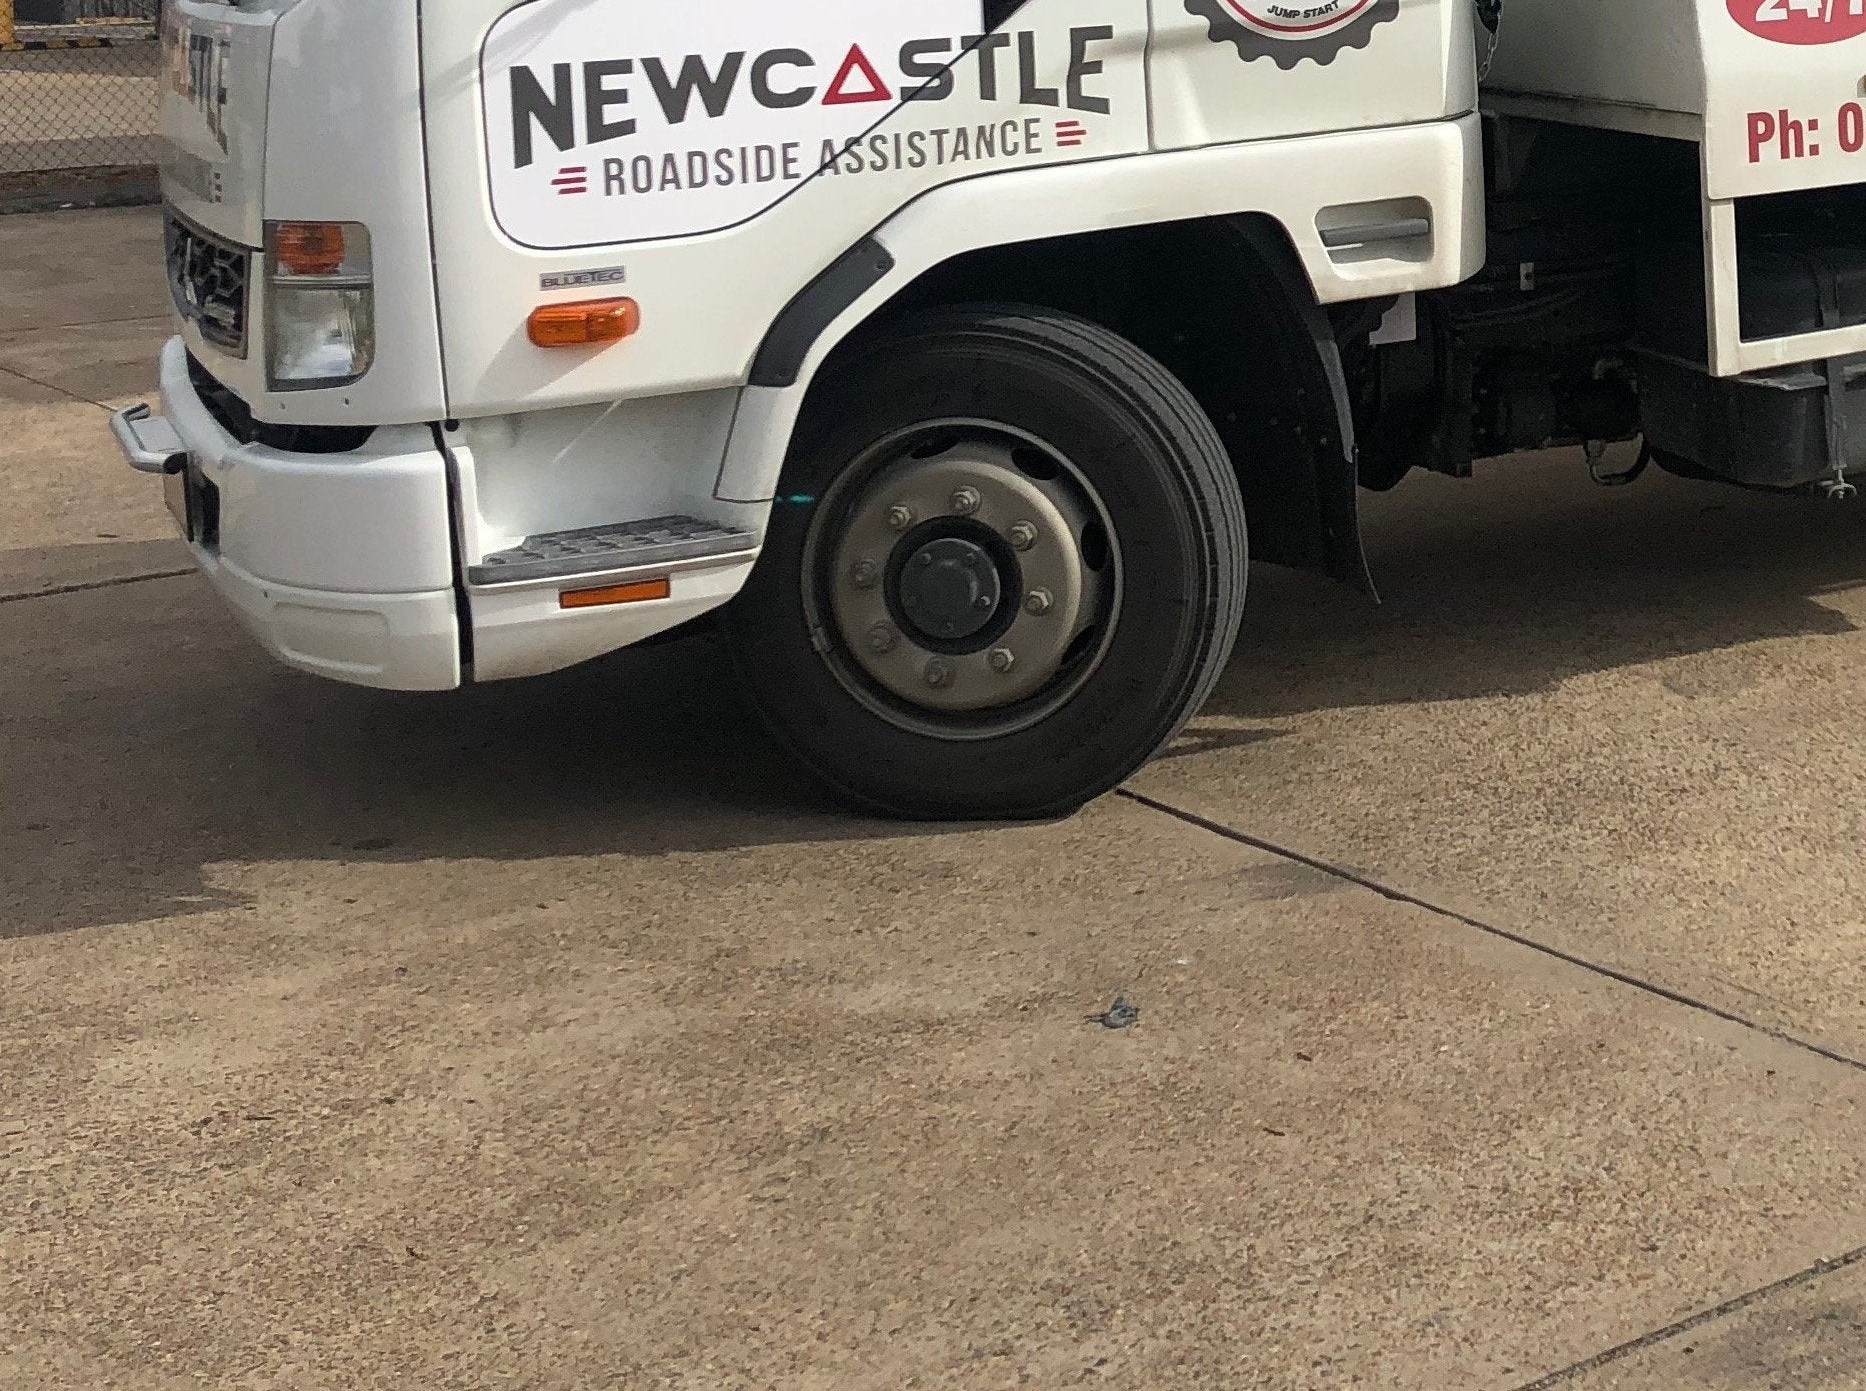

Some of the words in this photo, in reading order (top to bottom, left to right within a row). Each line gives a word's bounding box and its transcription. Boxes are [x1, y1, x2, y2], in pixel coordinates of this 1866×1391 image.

[1267, 4, 1300, 20] JUMP
[1302, 0, 1340, 19] START
[509, 25, 1113, 169] NEWCASTLE
[603, 141, 801, 197] ROADSIDE
[818, 117, 1043, 177] ASSISTANCE
[1746, 111, 1821, 164] Ph:
